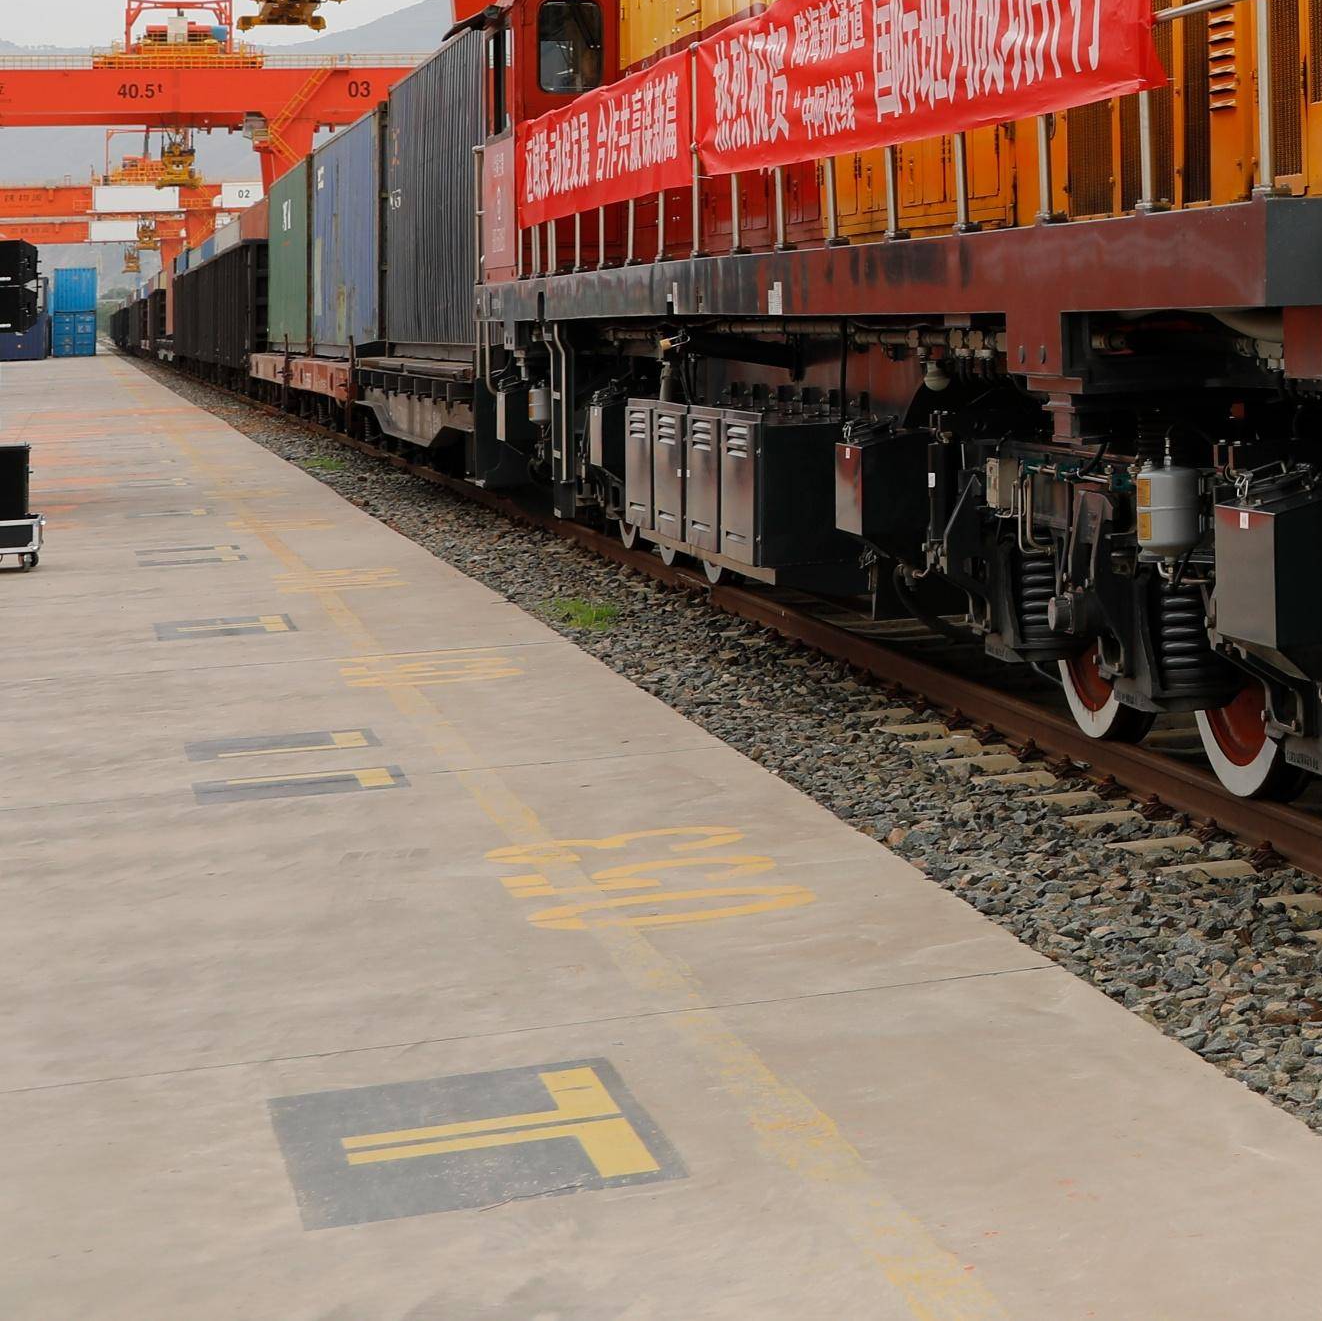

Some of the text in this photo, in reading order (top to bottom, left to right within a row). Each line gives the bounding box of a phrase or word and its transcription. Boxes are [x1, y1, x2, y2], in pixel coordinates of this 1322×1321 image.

[348, 81, 370, 98] 03
[713, 23, 789, 153] 热烈祝贺
[238, 189, 250, 199] 02
